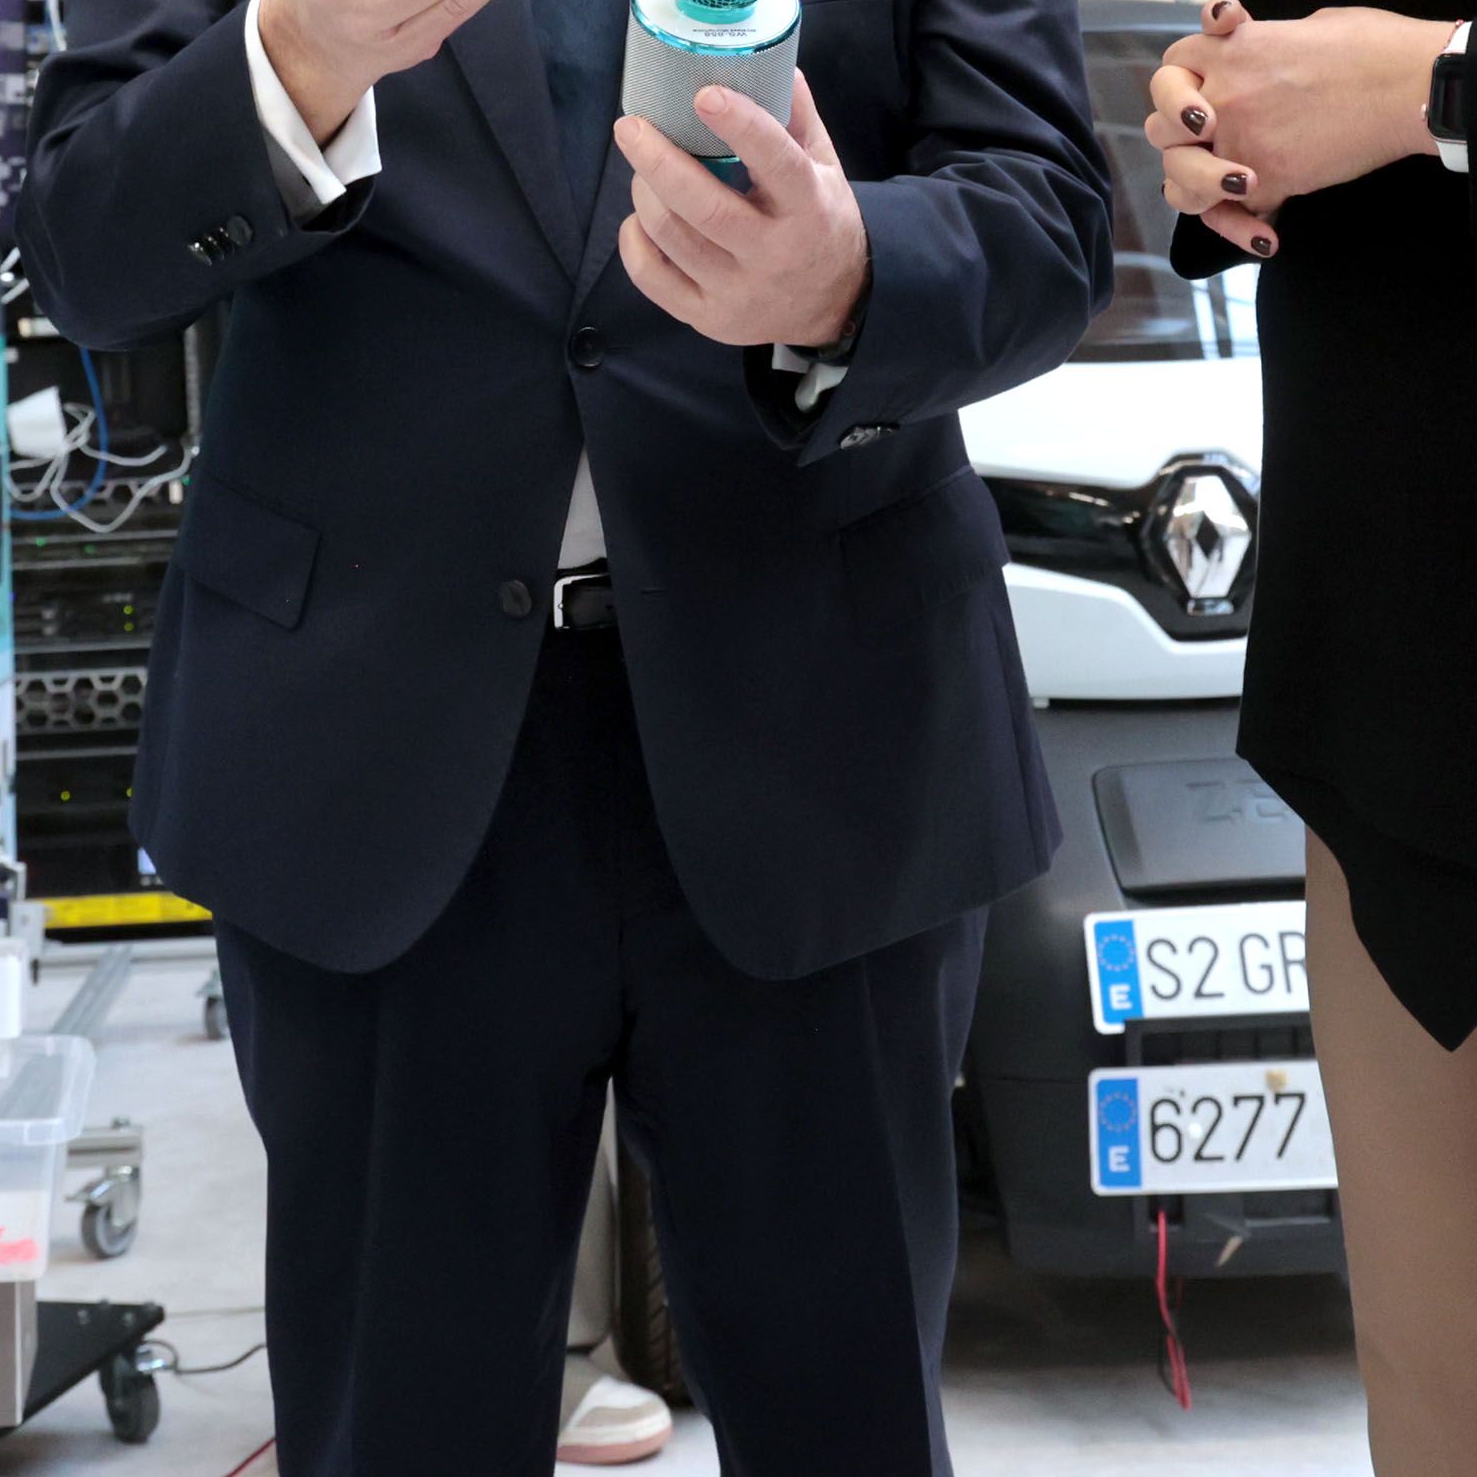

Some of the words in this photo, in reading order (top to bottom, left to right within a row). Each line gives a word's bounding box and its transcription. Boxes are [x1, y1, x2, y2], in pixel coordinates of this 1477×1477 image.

[1108, 983, 1132, 1011] E
[1147, 936, 1225, 1000] S2
[1107, 1145, 1131, 1173] E
[1150, 1092, 1307, 1164] 6277
